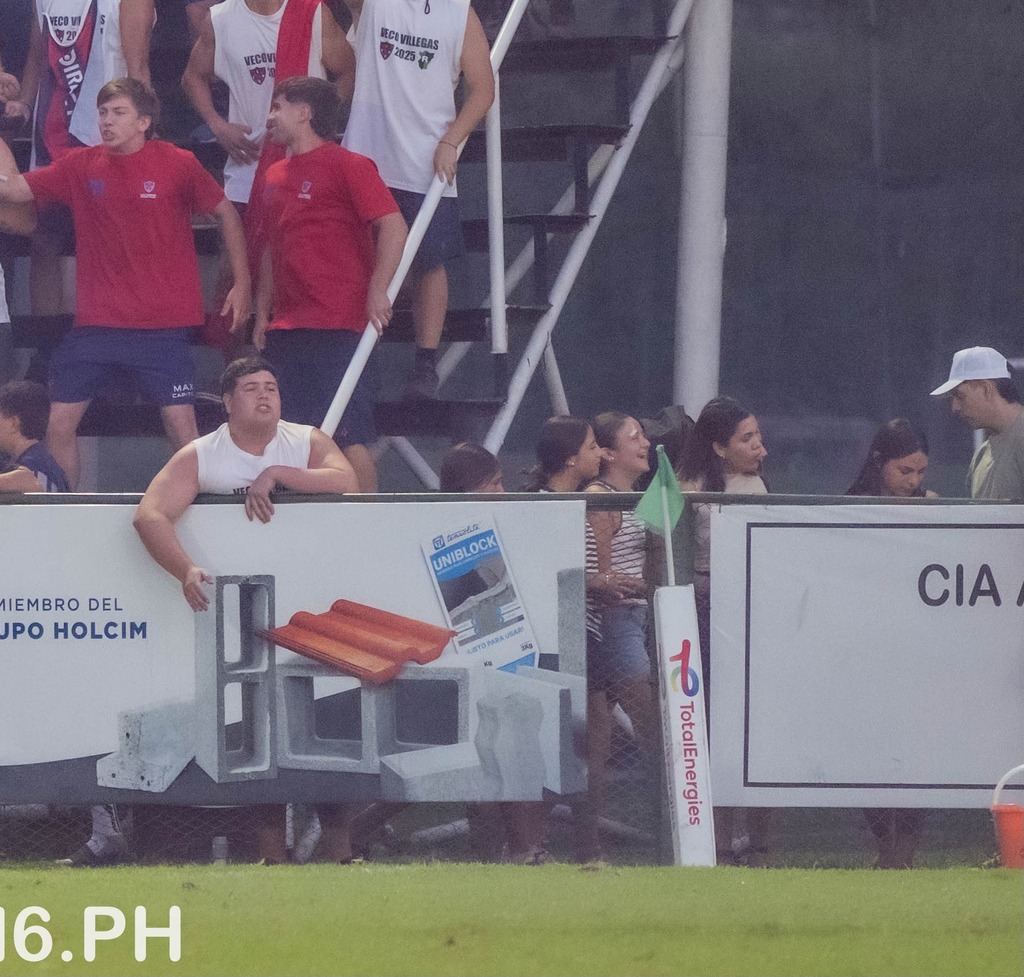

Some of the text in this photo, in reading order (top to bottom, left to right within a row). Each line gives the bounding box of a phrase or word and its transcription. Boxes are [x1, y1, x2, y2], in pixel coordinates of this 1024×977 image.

[400, 33, 439, 51] VILLEGAS
[243, 52, 266, 66] VECO
[394, 46, 416, 62] 2025
[433, 534, 497, 571] UNIBLOCK
[917, 563, 1002, 607] CIA
[88, 597, 123, 612] DEL
[53, 621, 147, 640] HOLCIM
[679, 701, 704, 826] TotalEnergies
